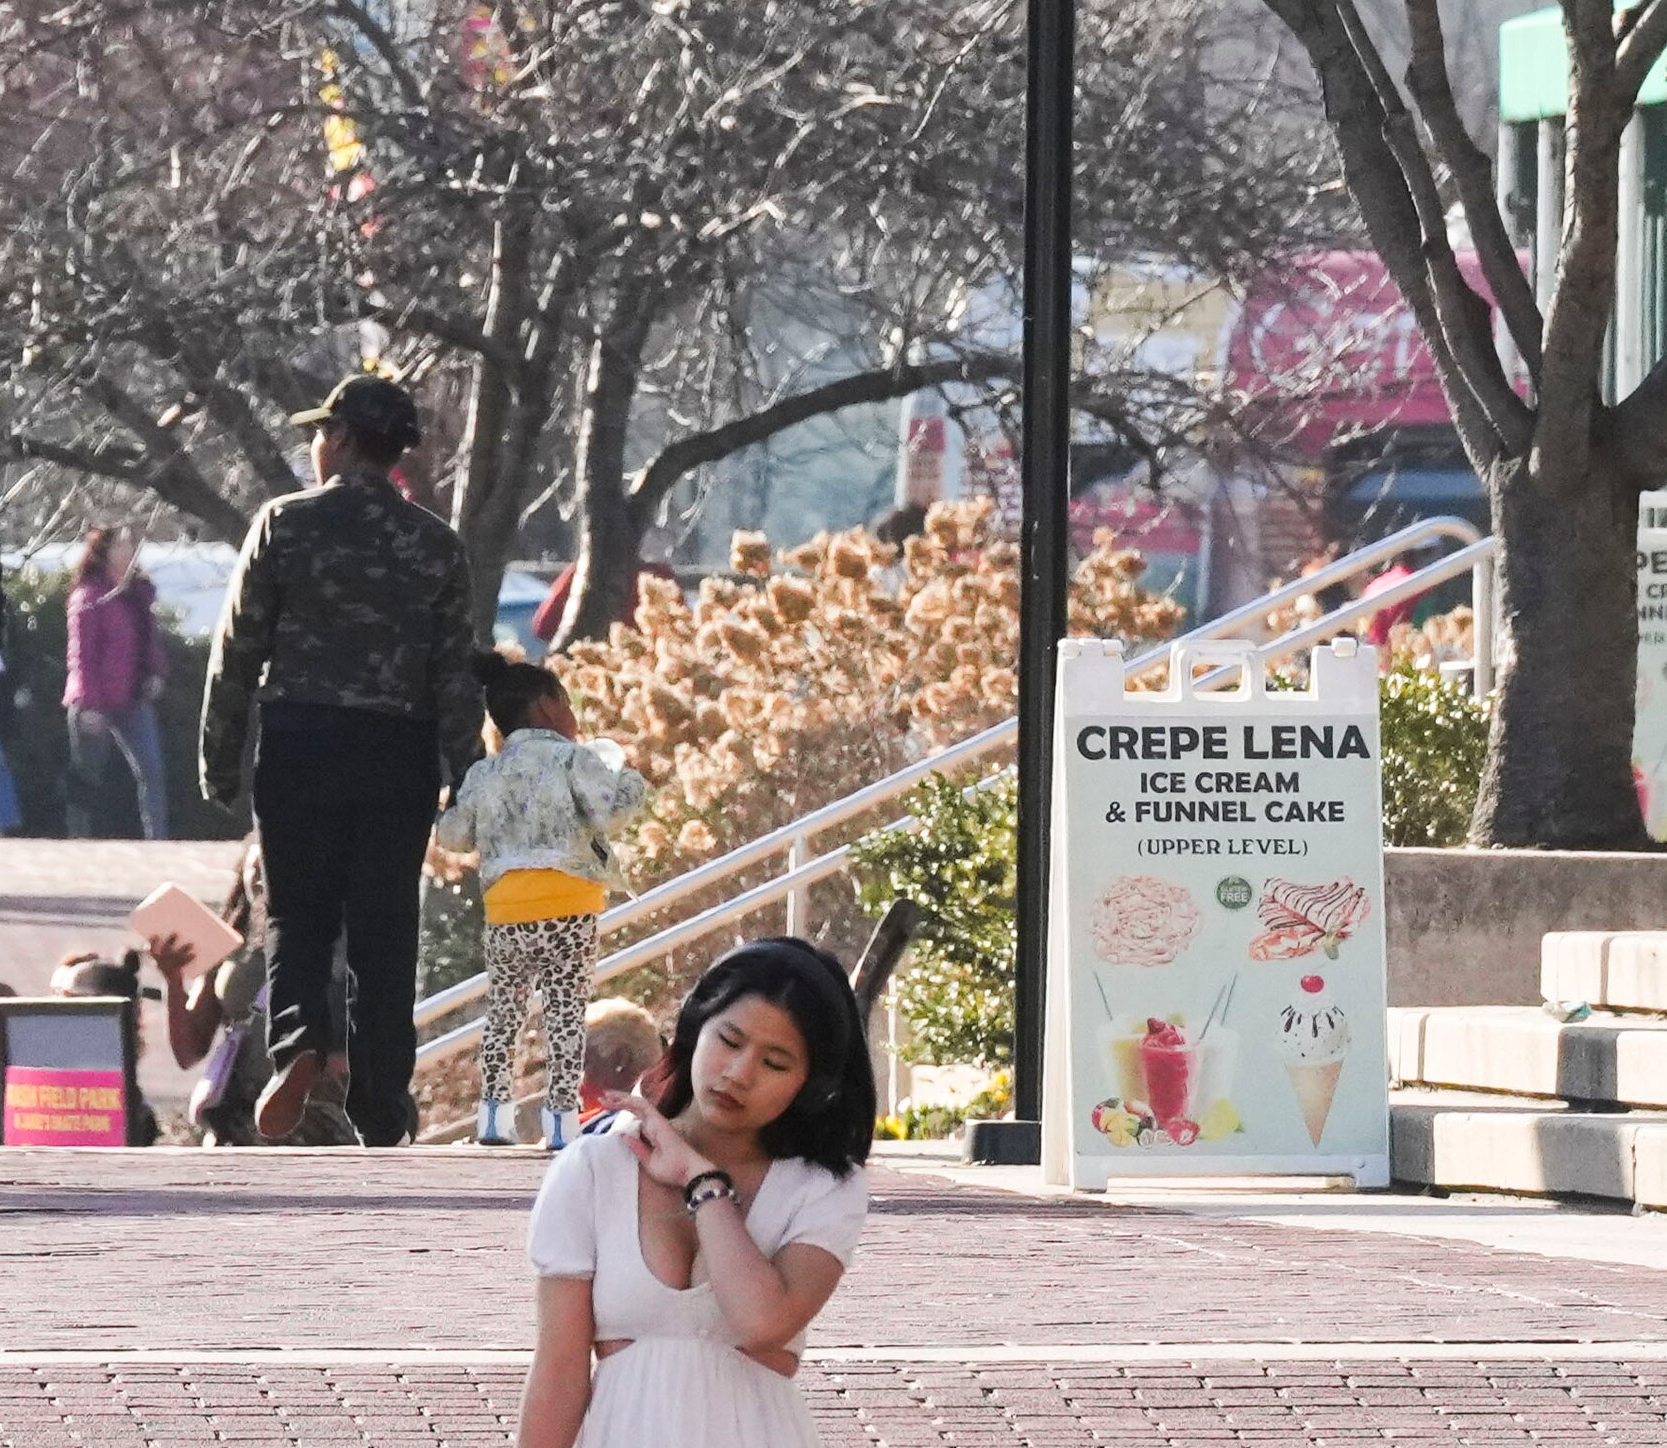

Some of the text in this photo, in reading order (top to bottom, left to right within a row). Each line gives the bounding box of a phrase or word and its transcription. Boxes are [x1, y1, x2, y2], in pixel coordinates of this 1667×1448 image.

[1076, 725, 1371, 760] CREPE LENA
[1139, 771, 1300, 793] ICE CREAM
[1105, 801, 1345, 824] & FUNNEL CAKE
[1137, 838, 1309, 857] (UPPER LEVEL)
[1220, 891, 1248, 903] FREE
